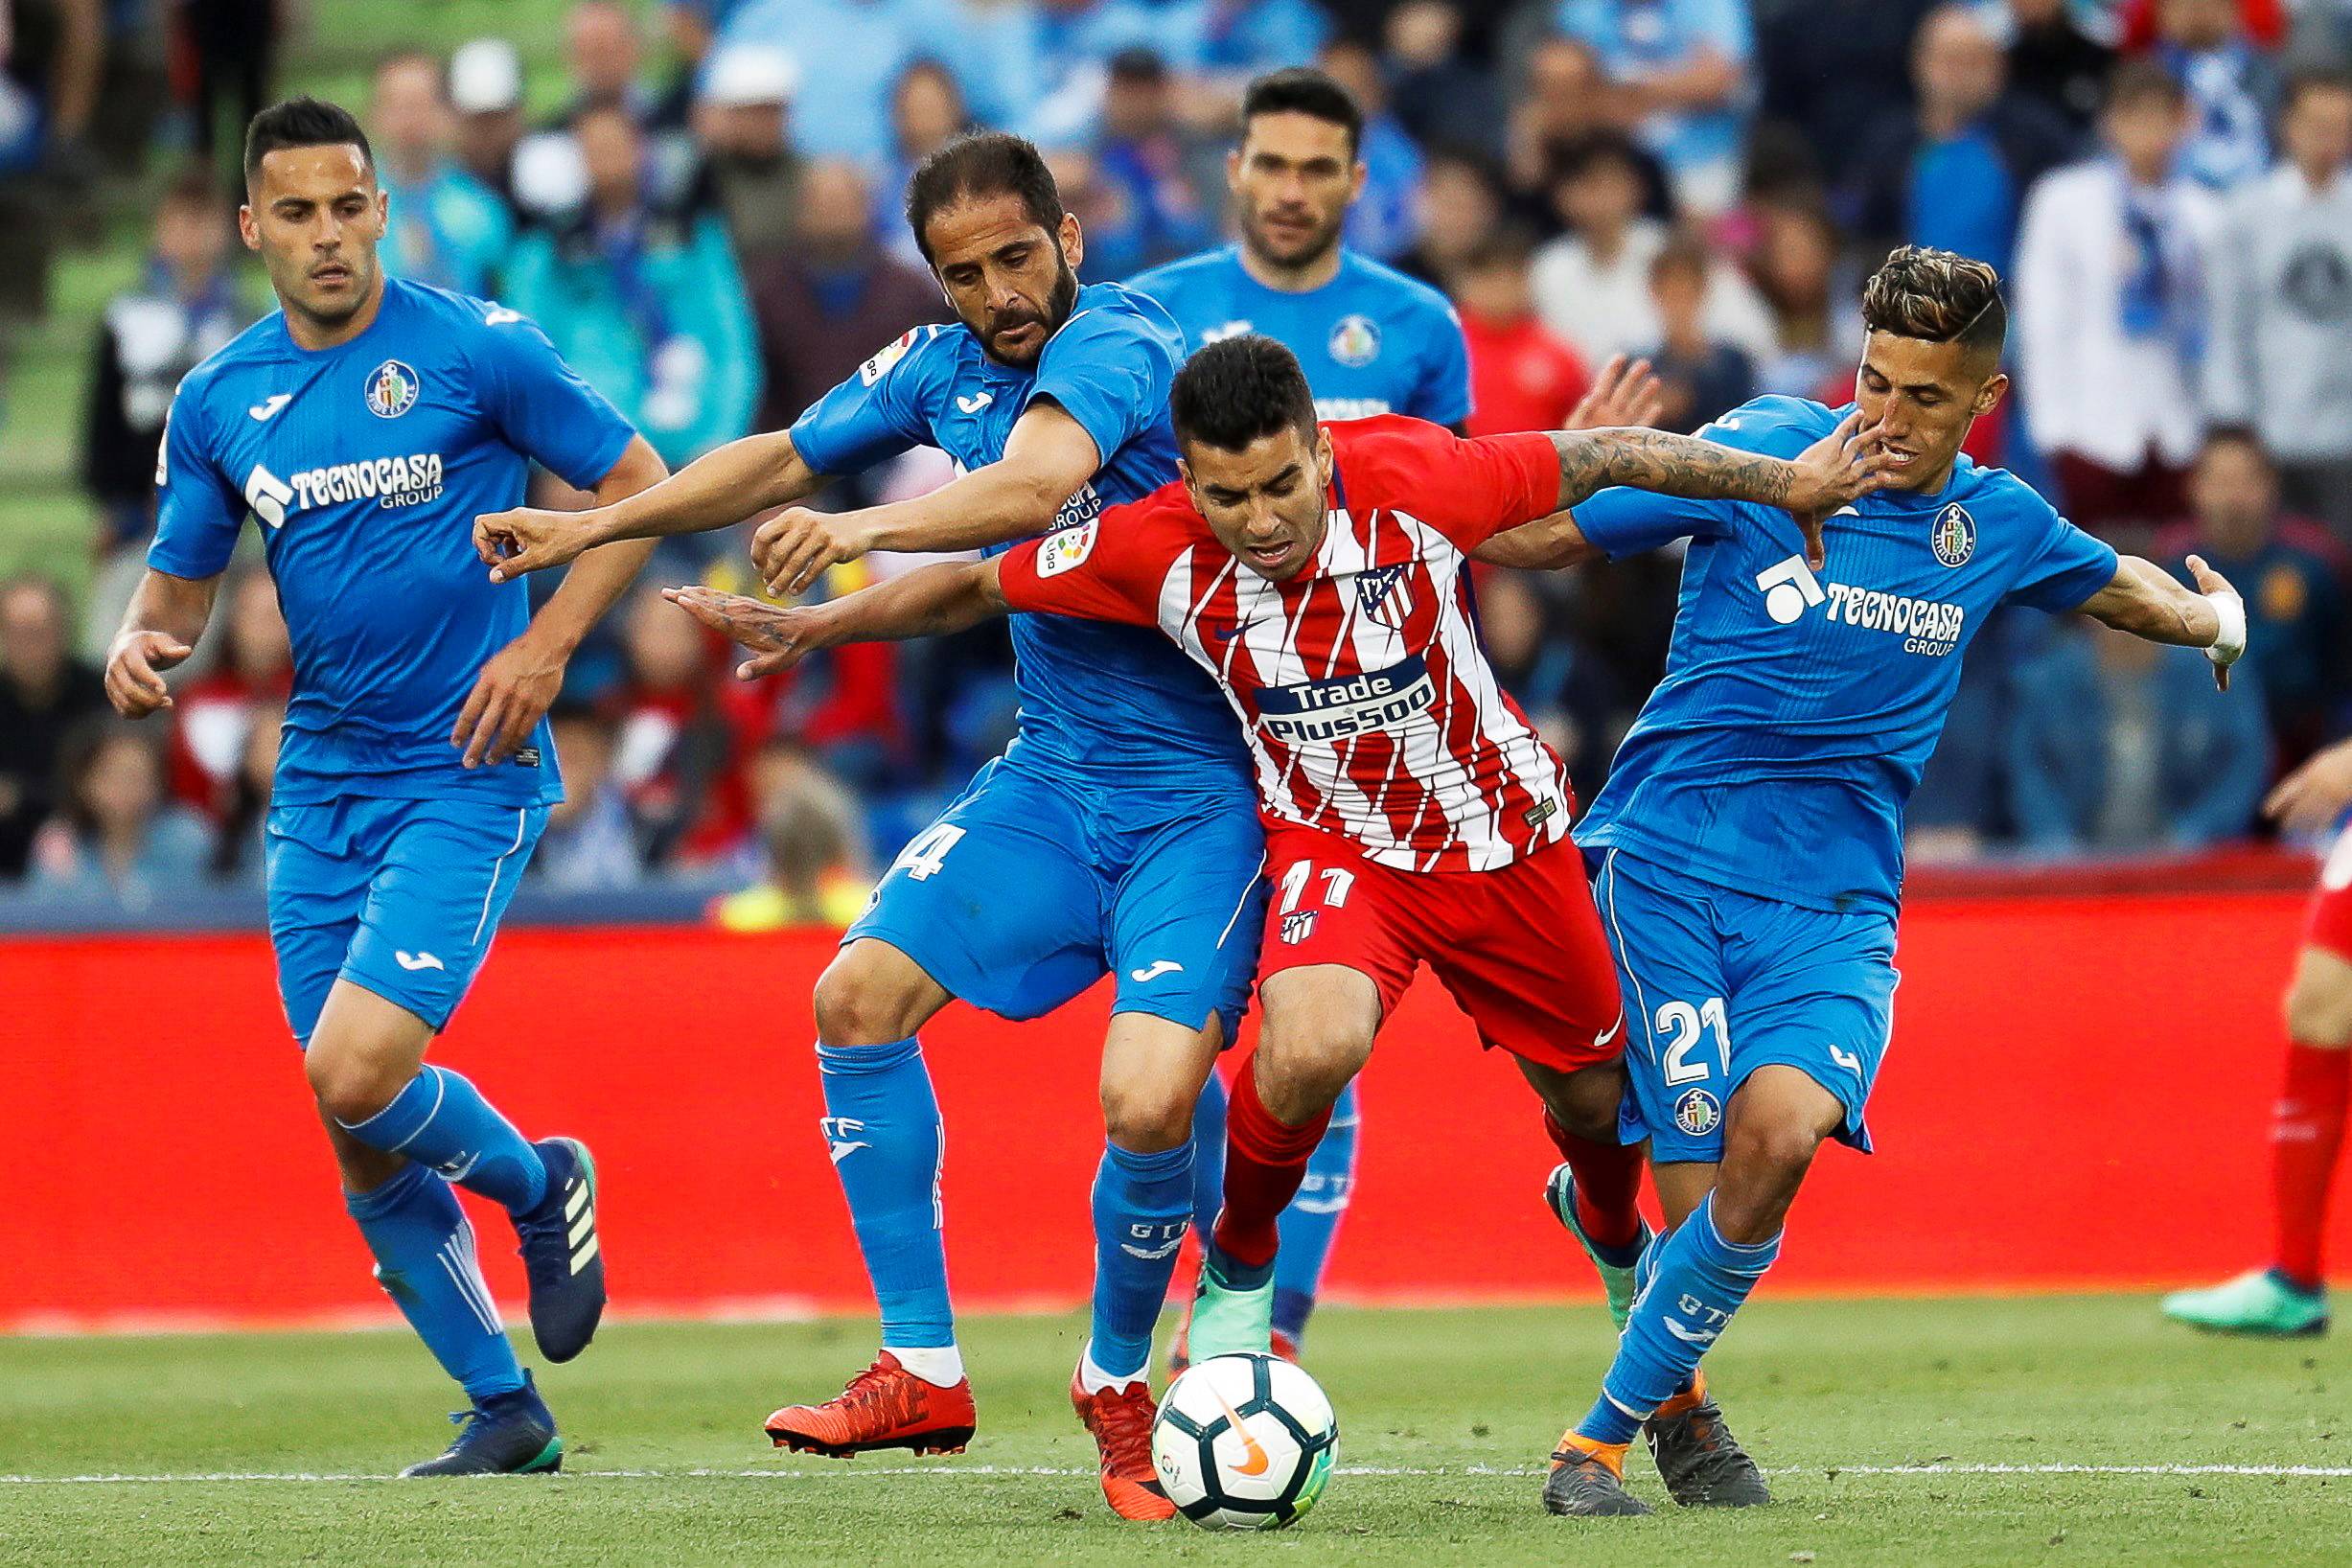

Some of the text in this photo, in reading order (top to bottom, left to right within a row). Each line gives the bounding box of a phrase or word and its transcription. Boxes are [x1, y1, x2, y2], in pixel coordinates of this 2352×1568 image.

[290, 453, 443, 510] TECNOCASA
[380, 485, 444, 509] GROUP
[1826, 582, 1965, 642] TECNOCASA
[1903, 636, 1954, 657] GROUP
[1267, 682, 1433, 743] Plus500
[1288, 674, 1393, 710] Trade
[895, 822, 967, 882] 4
[1279, 859, 1356, 916] 11
[1655, 997, 1731, 1087] 21
